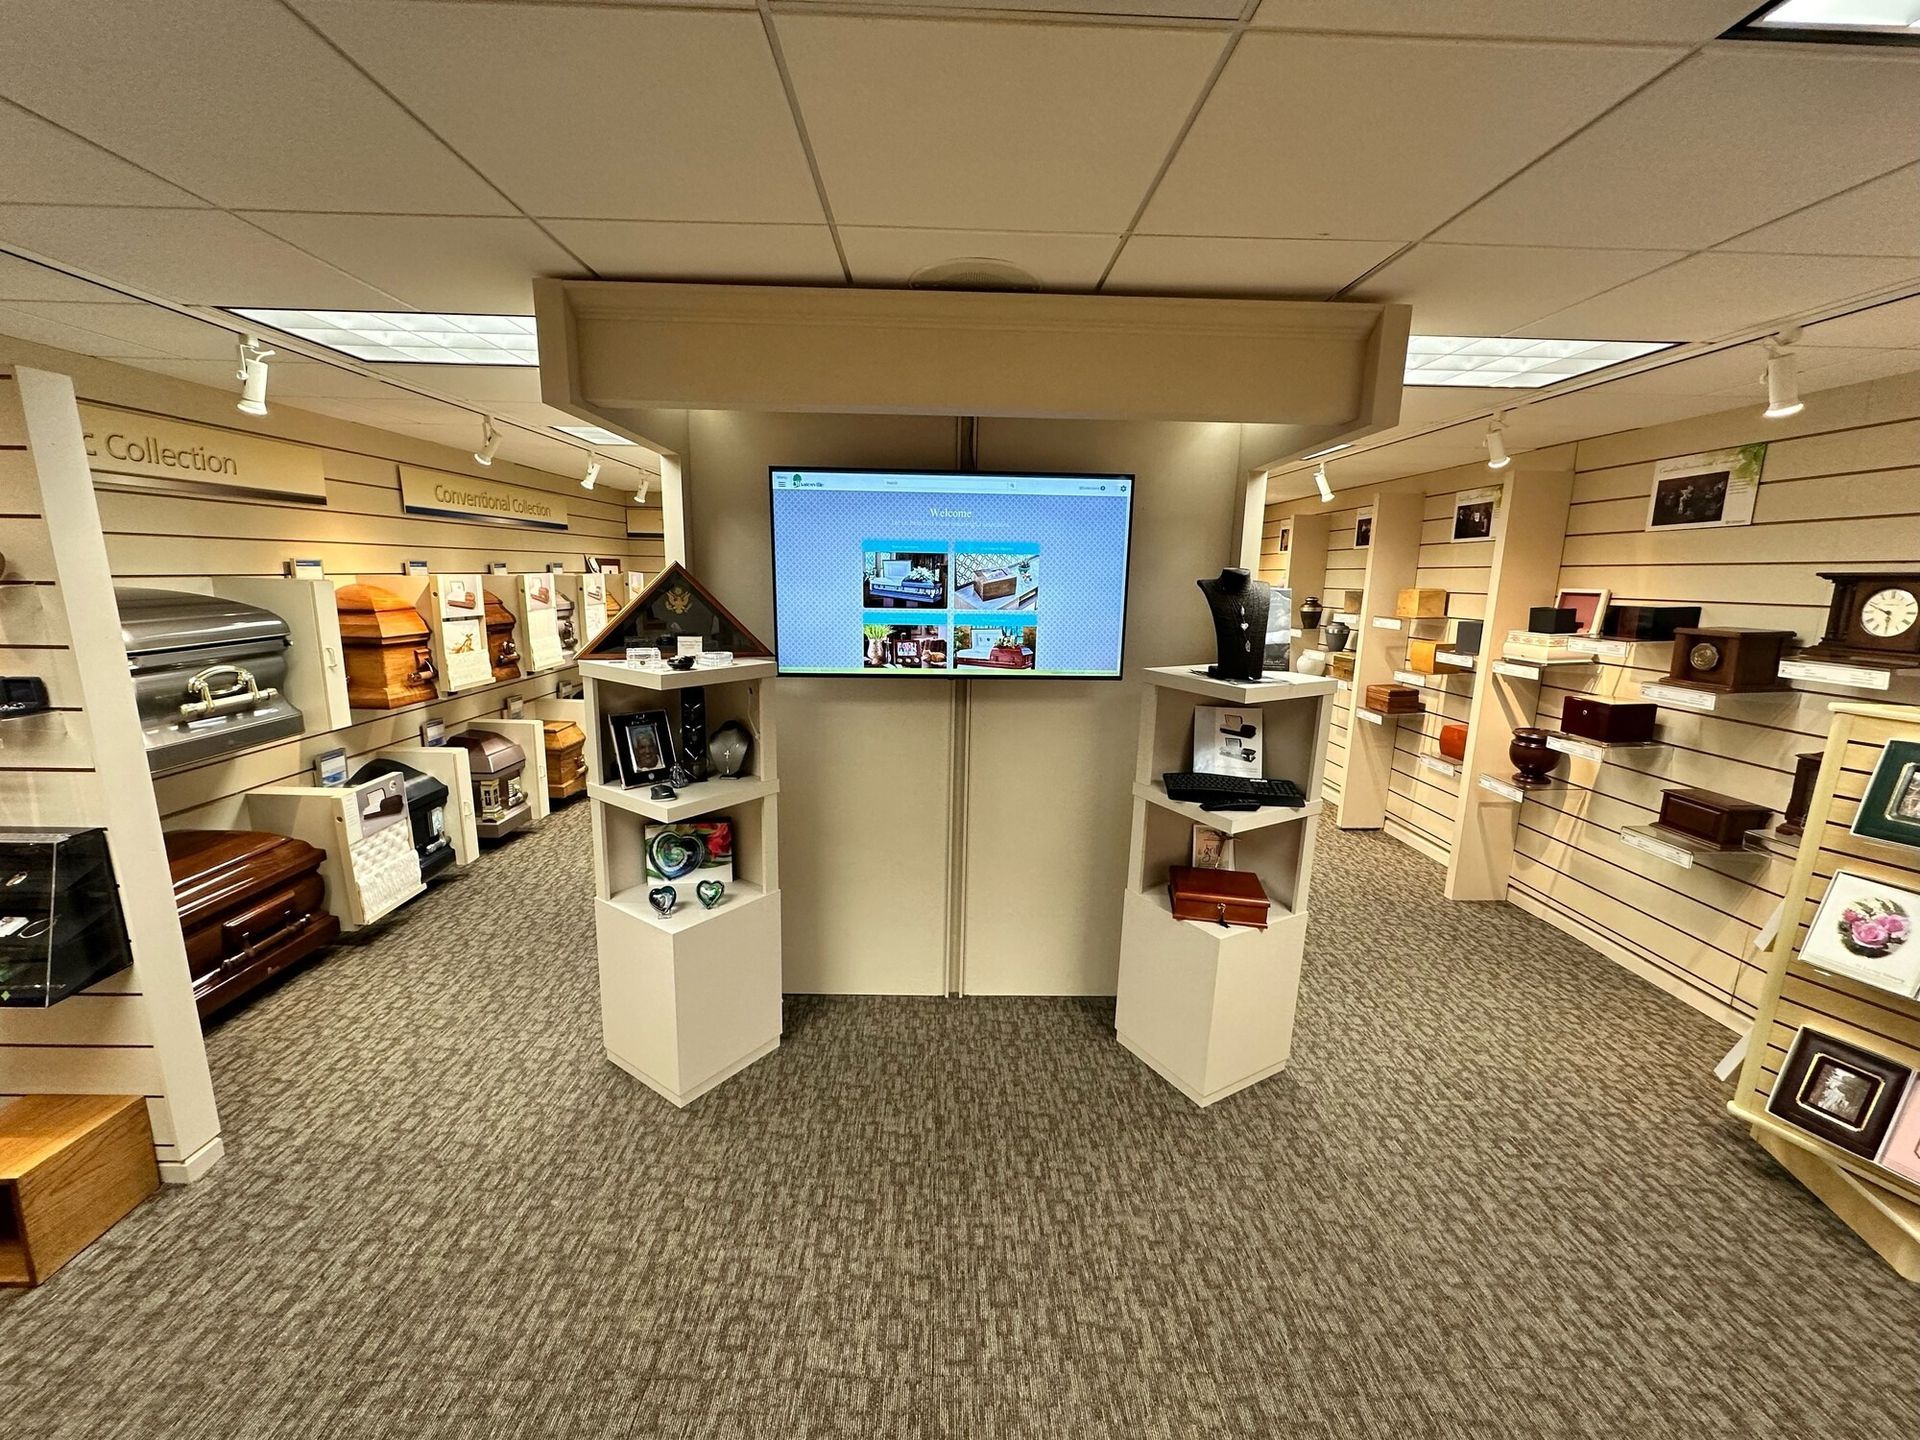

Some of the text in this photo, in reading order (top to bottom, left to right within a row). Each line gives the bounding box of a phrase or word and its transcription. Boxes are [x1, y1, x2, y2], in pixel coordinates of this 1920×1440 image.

[105, 434, 238, 475] Collection
[434, 484, 552, 518] Conventional Collection
[930, 508, 972, 518] Welcome
